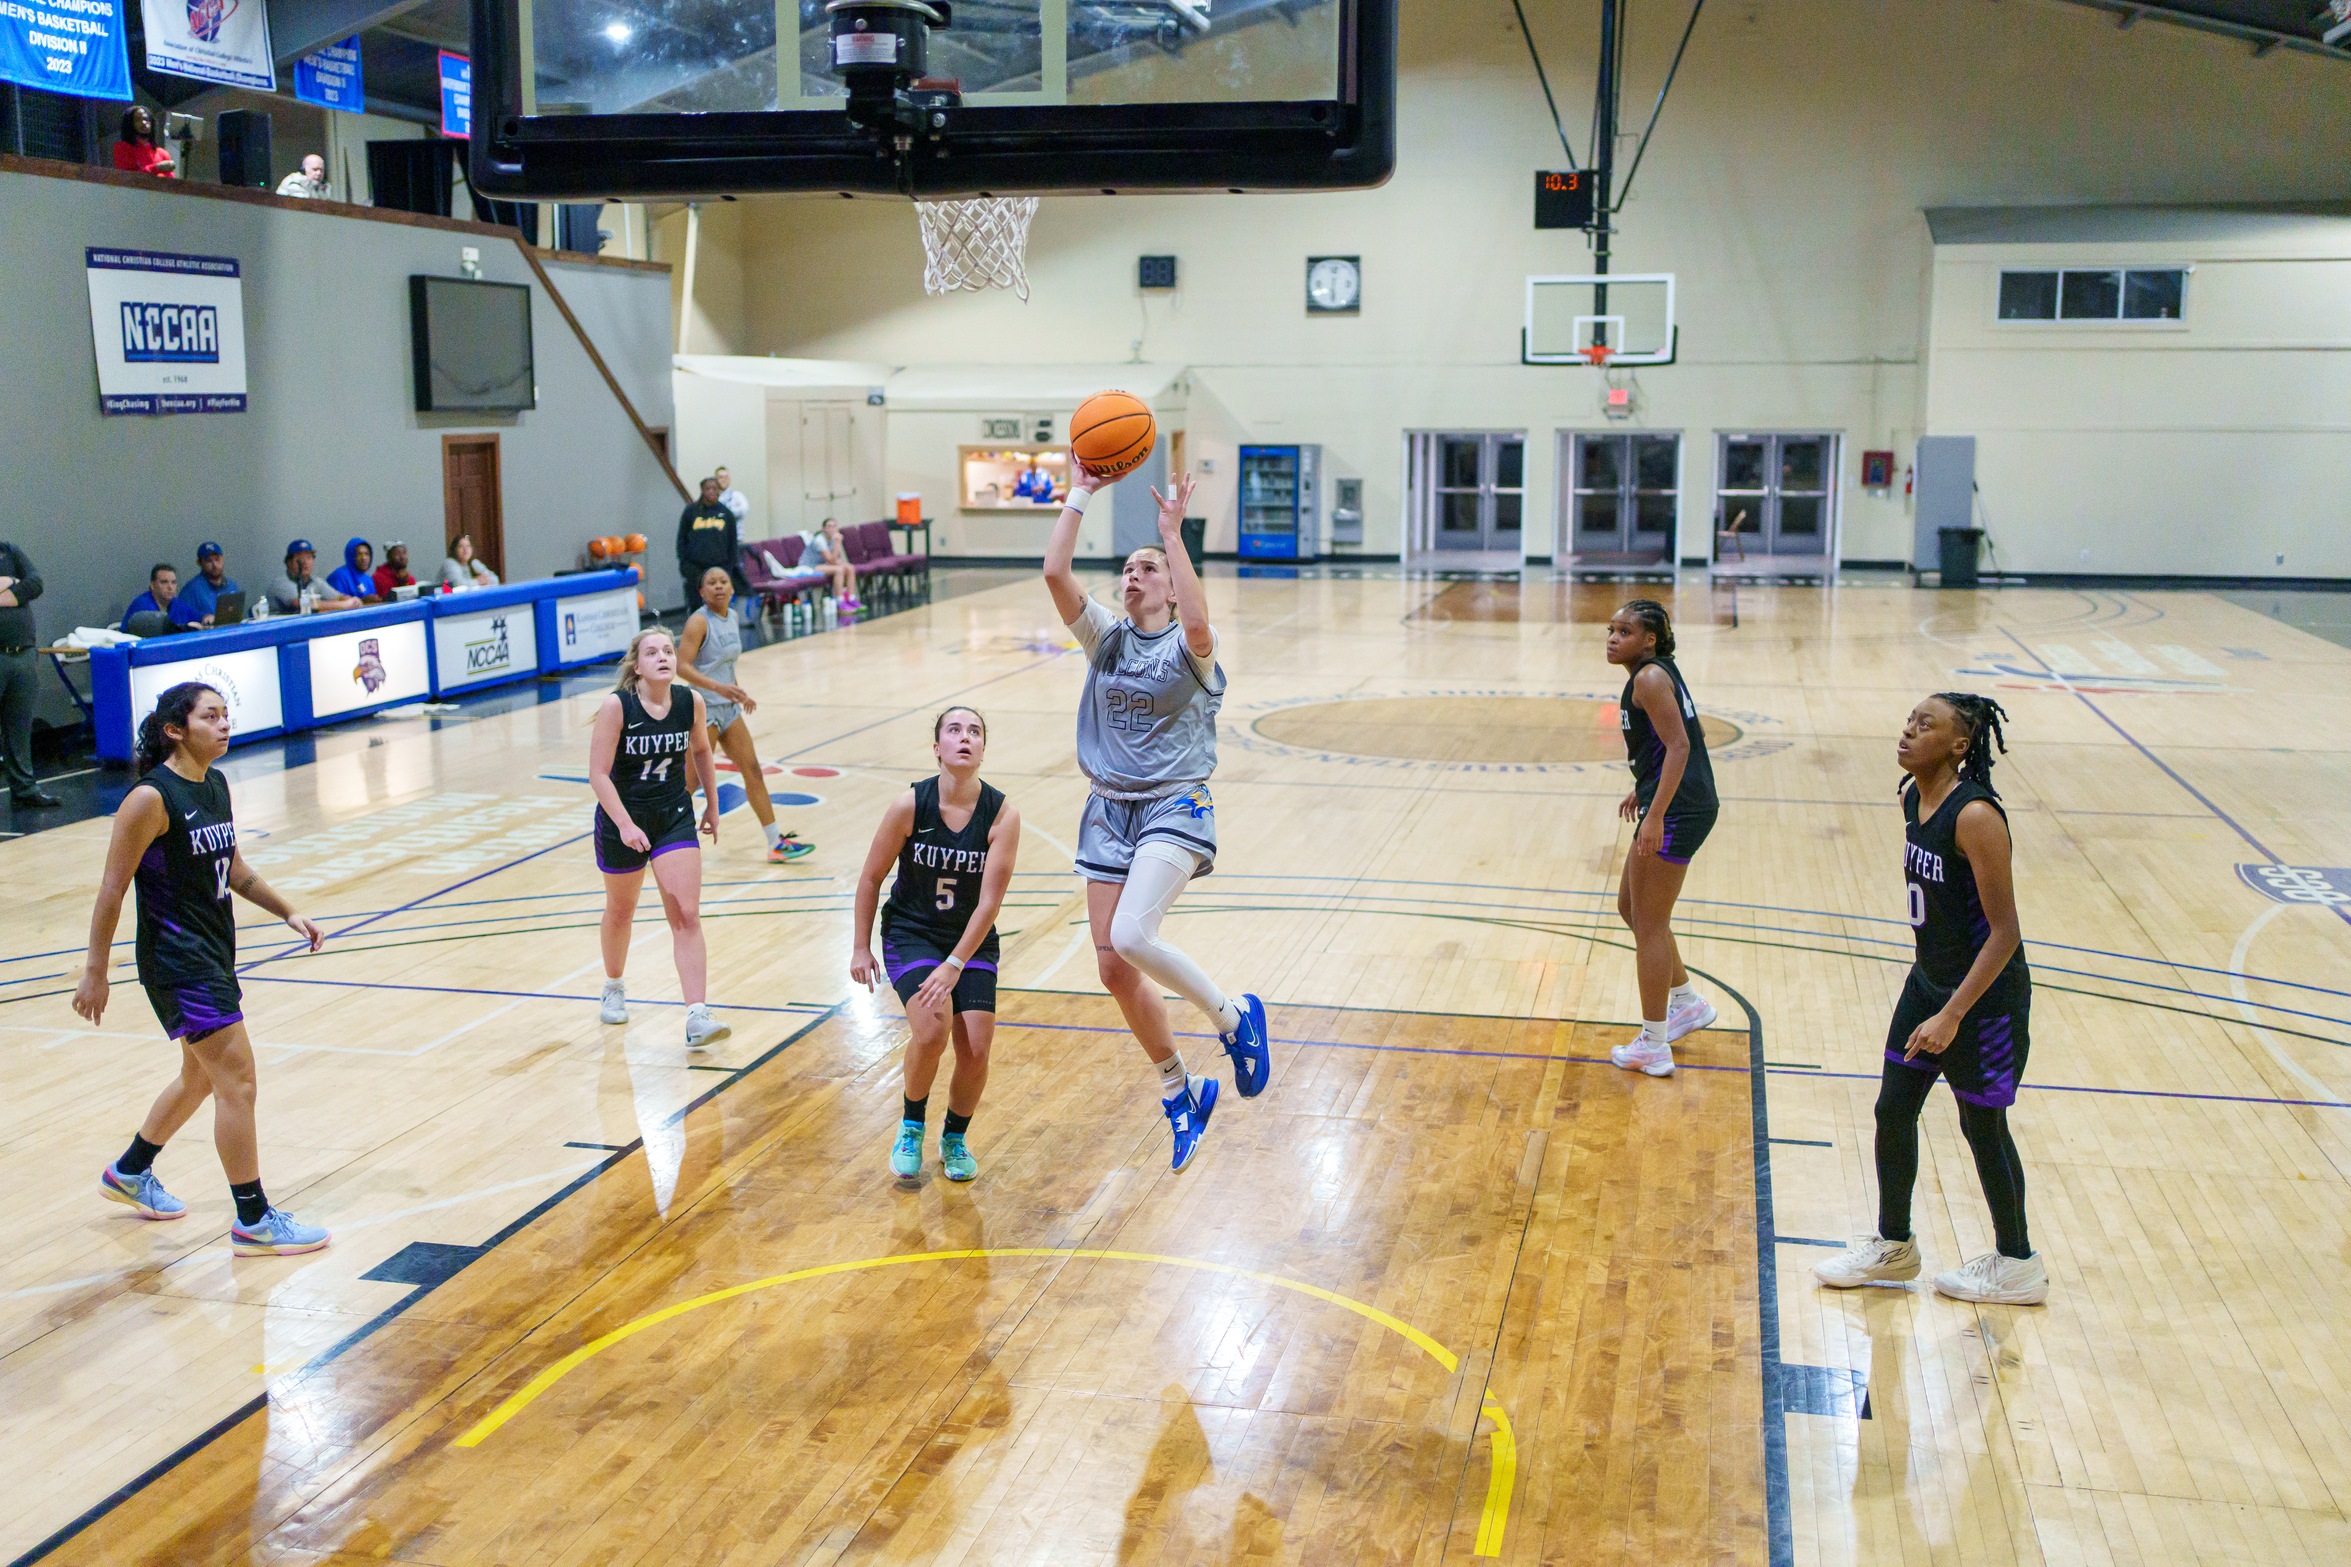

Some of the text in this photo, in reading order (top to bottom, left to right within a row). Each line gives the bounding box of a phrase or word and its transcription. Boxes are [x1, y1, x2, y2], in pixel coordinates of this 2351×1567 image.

[37, 11, 109, 37] BASKETBALL
[29, 30, 88, 55] DIVISION II
[46, 57, 73, 75] 2023
[1545, 173, 1578, 191] 10.3
[121, 302, 217, 353] NCCAA
[1091, 446, 1149, 474] Wilson
[467, 642, 509, 669] NCCAA
[1106, 688, 1154, 732] 22
[640, 757, 673, 782] 14
[189, 821, 236, 855] KUYPE
[935, 877, 958, 911] 5
